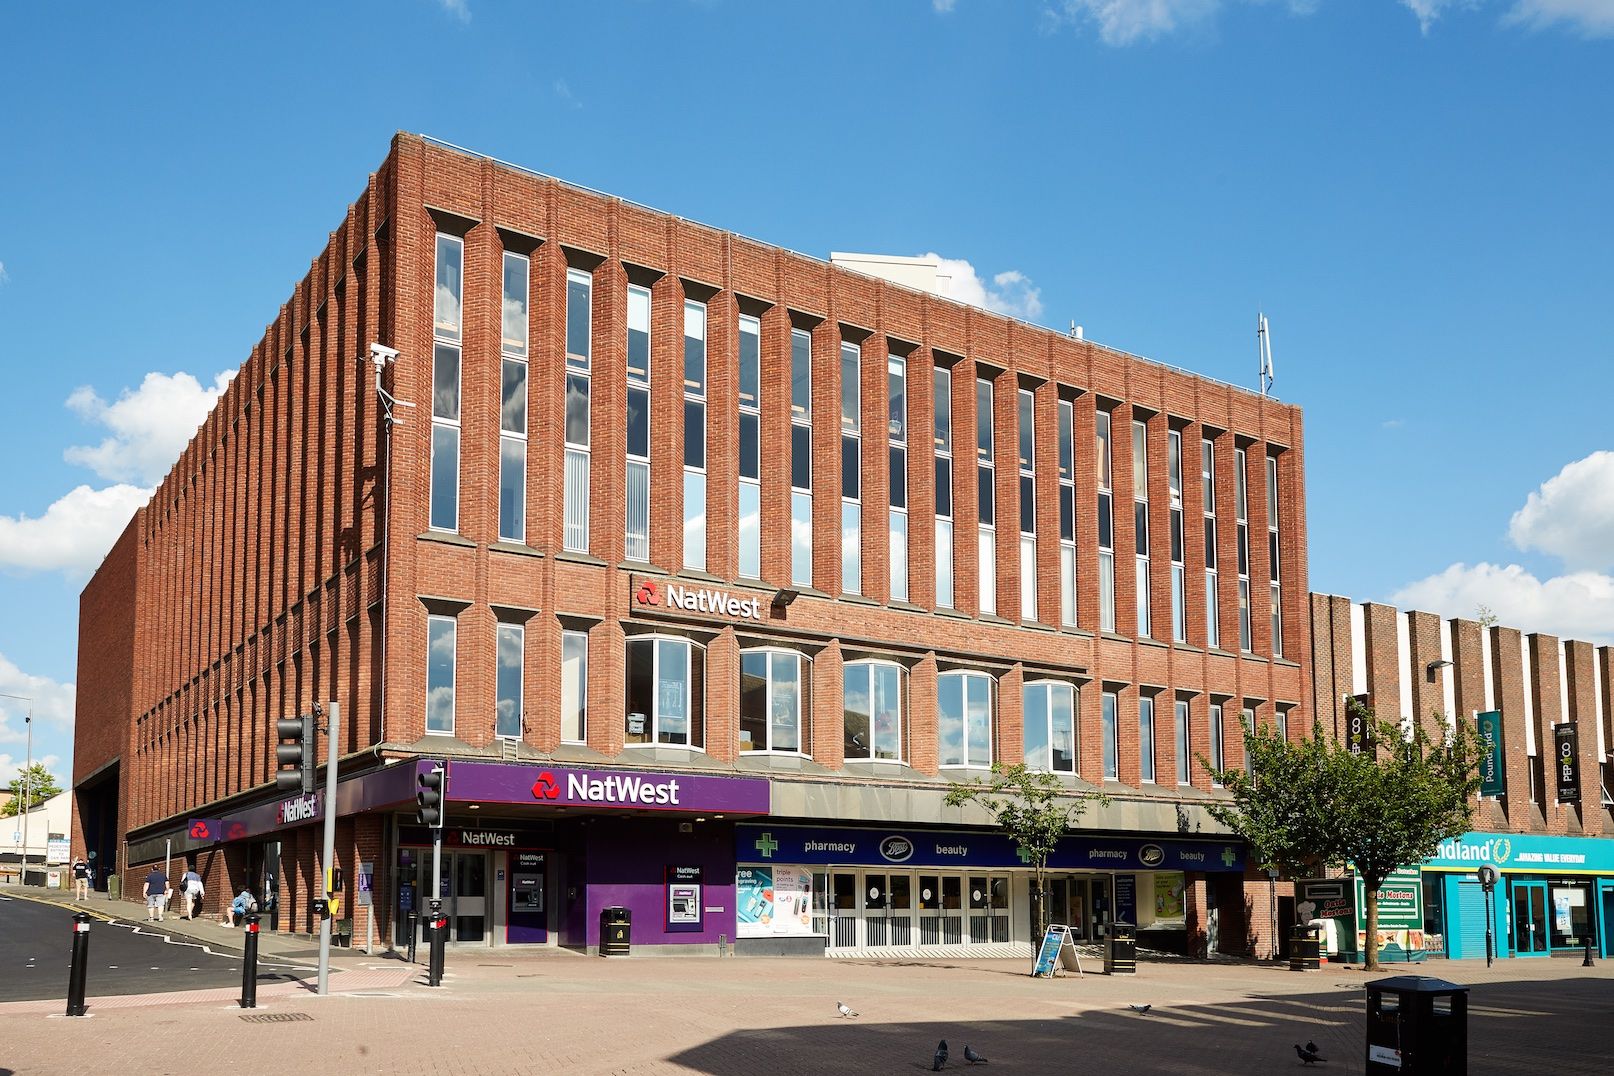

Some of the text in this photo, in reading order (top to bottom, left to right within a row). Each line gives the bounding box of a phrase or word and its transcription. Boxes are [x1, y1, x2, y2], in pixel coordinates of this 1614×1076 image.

[667, 585, 760, 619] NatWest
[1484, 732, 1494, 783] Poundnd
[567, 773, 680, 805] NatWest
[284, 795, 316, 823] NatWest
[462, 831, 515, 846] NatWest
[804, 840, 968, 858] pharmacy Boots beauty
[1088, 849, 1128, 860] pharmacy
[1180, 850, 1205, 863] beauty
[1429, 840, 1490, 861] ndland
[1544, 853, 1560, 863] VALUE
[737, 870, 753, 878] ree
[1386, 890, 1413, 899] Mostons
[1320, 907, 1353, 918] Mostons
